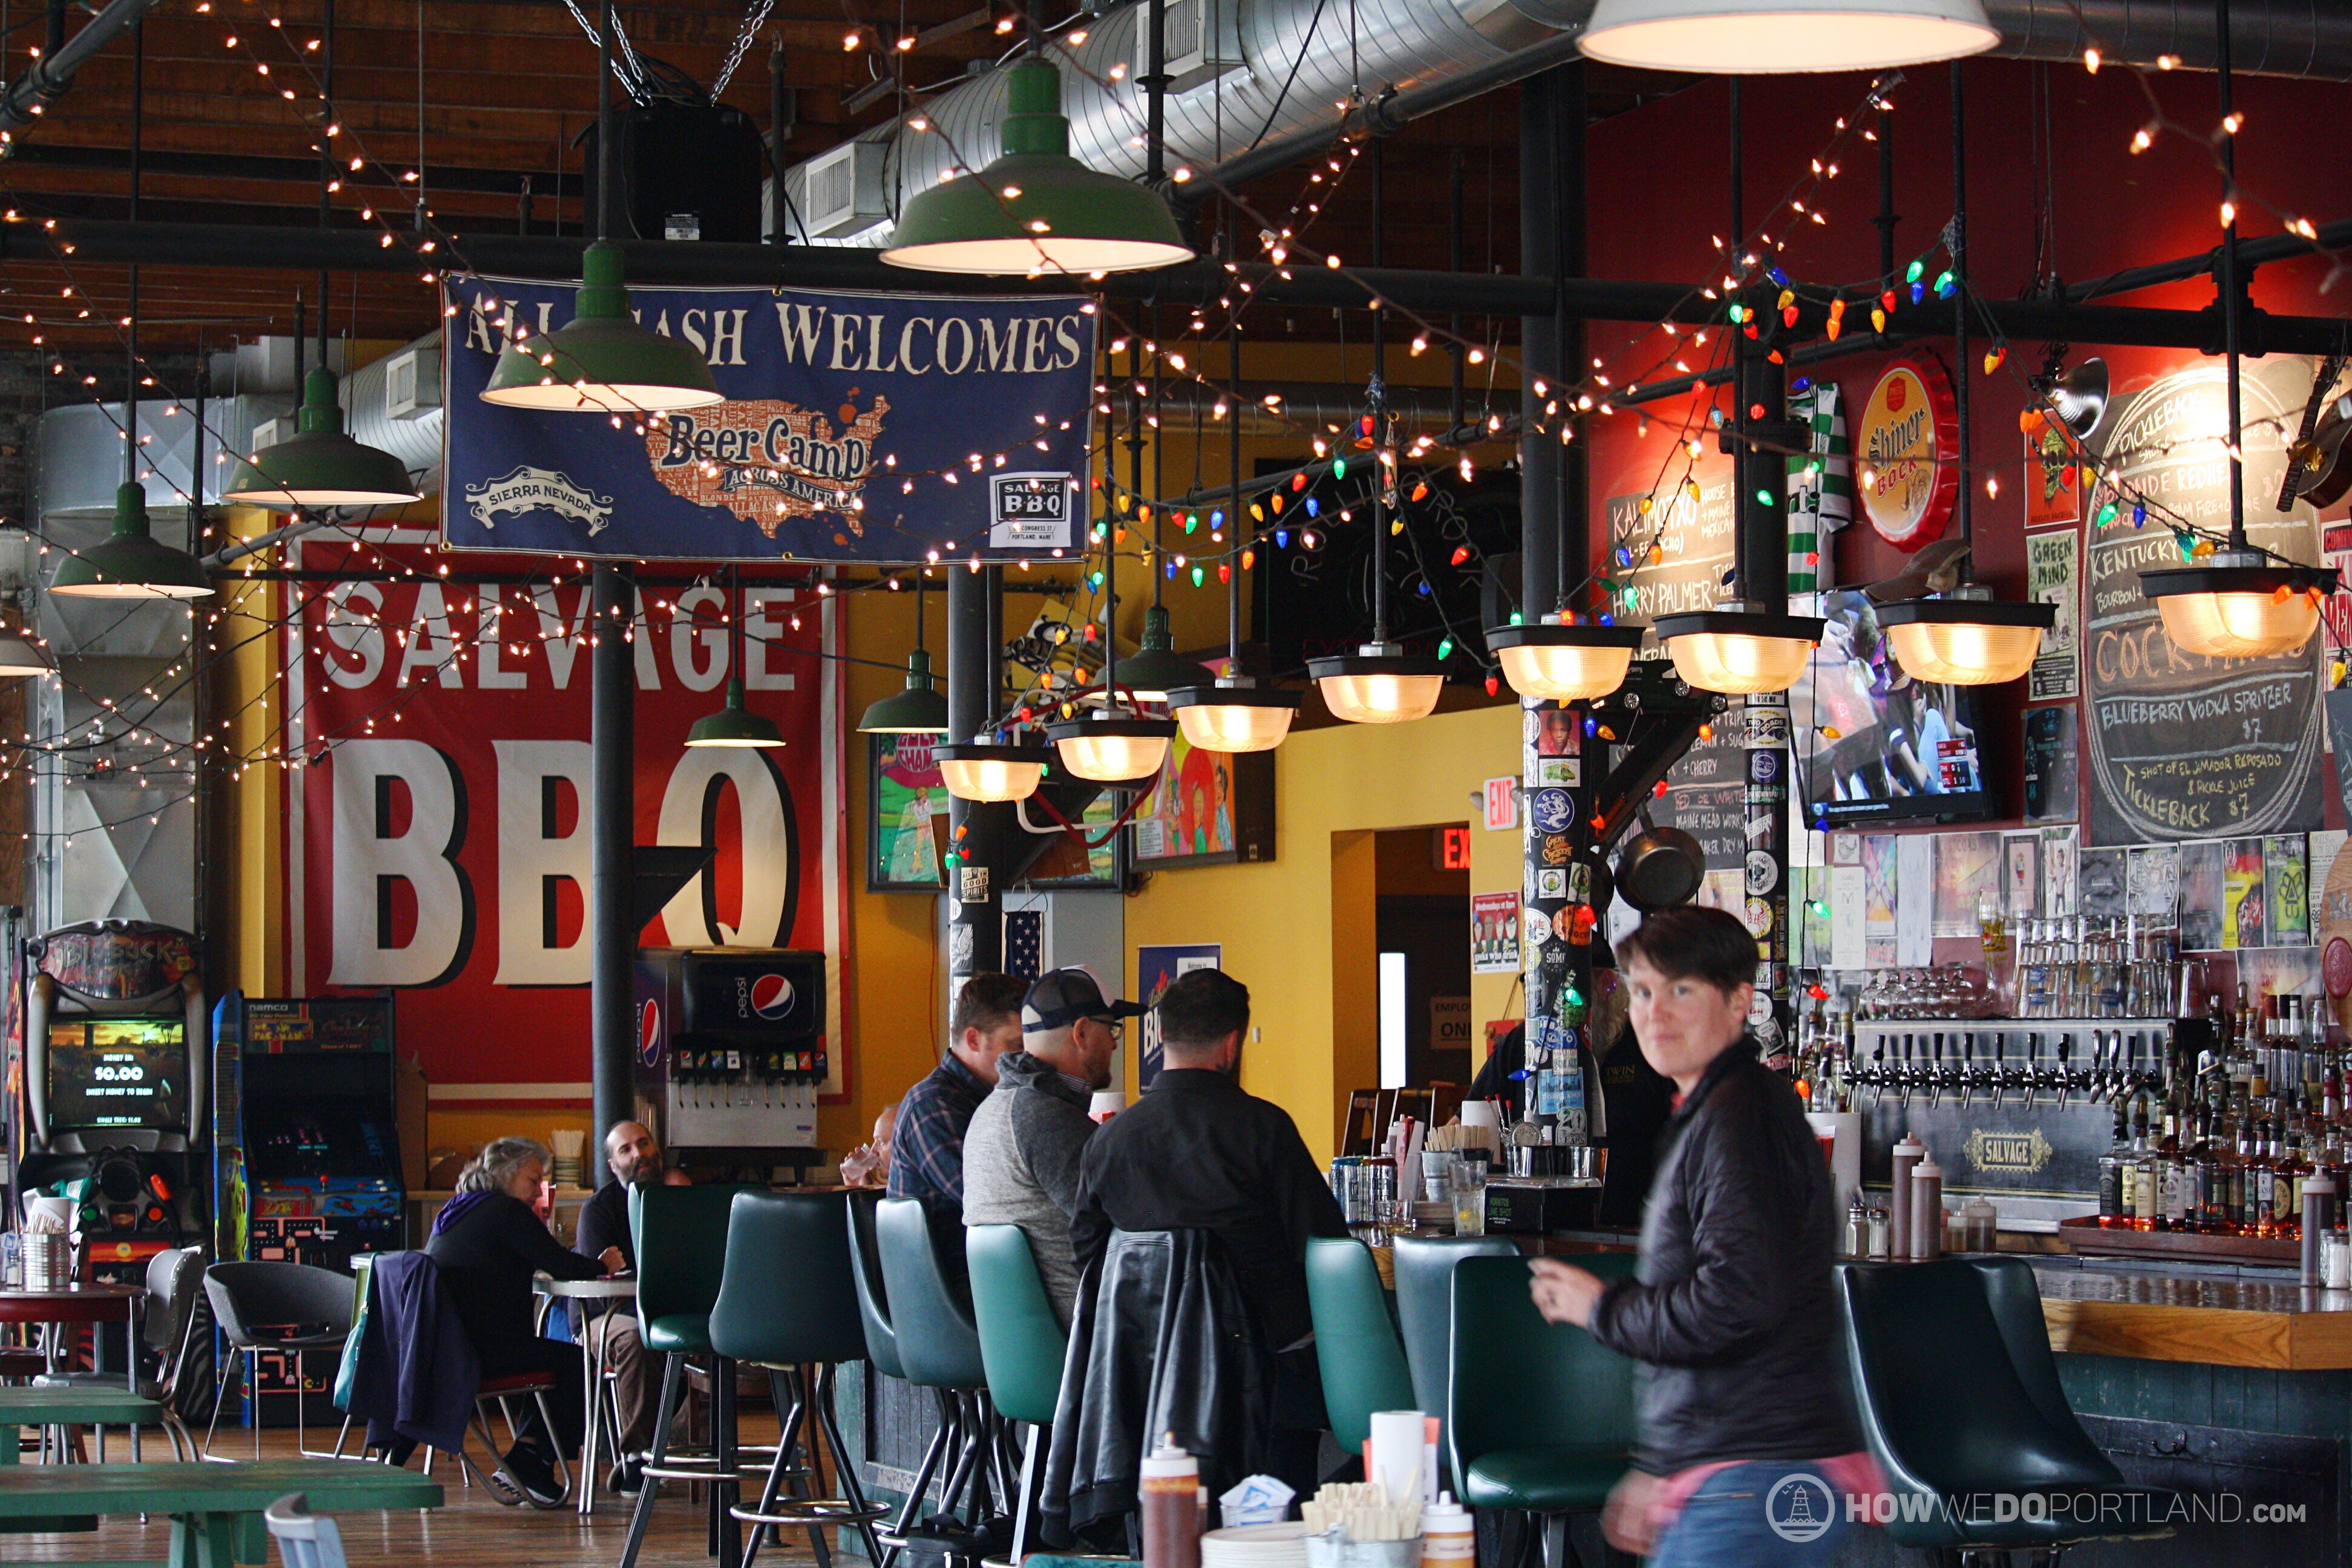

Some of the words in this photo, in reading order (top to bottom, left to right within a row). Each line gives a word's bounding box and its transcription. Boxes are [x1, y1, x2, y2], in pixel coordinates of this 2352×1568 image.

[465, 292, 748, 365] ALLSH
[775, 302, 1081, 374] WELCOMES
[662, 415, 761, 467] Beer
[765, 419, 867, 483] Camp
[1868, 407, 1926, 474] Shiner
[730, 467, 789, 489] ACROSS
[791, 480, 859, 509] AMERICA
[1004, 484, 1060, 493] SALAGE
[1877, 453, 1917, 499] BOCK
[489, 485, 540, 505] SIERRA
[2103, 474, 2171, 506] BONDE
[1613, 492, 1697, 542] KALIMOTXO
[1700, 485, 1726, 507] HOUSE
[2033, 538, 2071, 564] GREEN
[2090, 540, 2178, 586] KENTUCKY
[2037, 563, 2068, 585] MIND
[1658, 579, 1711, 614] PALMER
[2101, 701, 2187, 730] BLUEBERRY
[2187, 694, 2231, 721] VODKA
[2234, 682, 2292, 713] SPRITZER
[1760, 718, 1783, 733] ROADS
[2242, 718, 2262, 742] $7
[2141, 763, 2163, 779] SHOT
[2166, 763, 2177, 775] OF
[2180, 763, 2191, 776] EL
[2234, 754, 2282, 769] REPOSADO
[2122, 764, 2211, 828] TICKLEBACK
[2197, 779, 2224, 794] PICKLE
[2228, 773, 2255, 794] JUICE
[1489, 779, 1512, 826] EXIT
[1714, 789, 1745, 805] WHITE
[2229, 792, 2250, 821] $7
[1676, 816, 1699, 829] MAINE
[1701, 815, 1720, 829] MEAD
[1443, 829, 1471, 869] EX
[1546, 835, 1566, 847] GREAT
[326, 739, 801, 988] BBQ
[962, 884, 988, 898] SPIRITS
[964, 878, 987, 887] GOOD
[1489, 950, 1502, 961] who
[1502, 949, 1518, 959] drink
[249, 1004, 289, 1012] namco
[735, 976, 749, 1018] pepsi
[1436, 1004, 1469, 1012] EMPLO
[1441, 1022, 1472, 1037] ON
[94, 1067, 143, 1081] $0.00
[1985, 1140, 2028, 1163] SALVAGE
